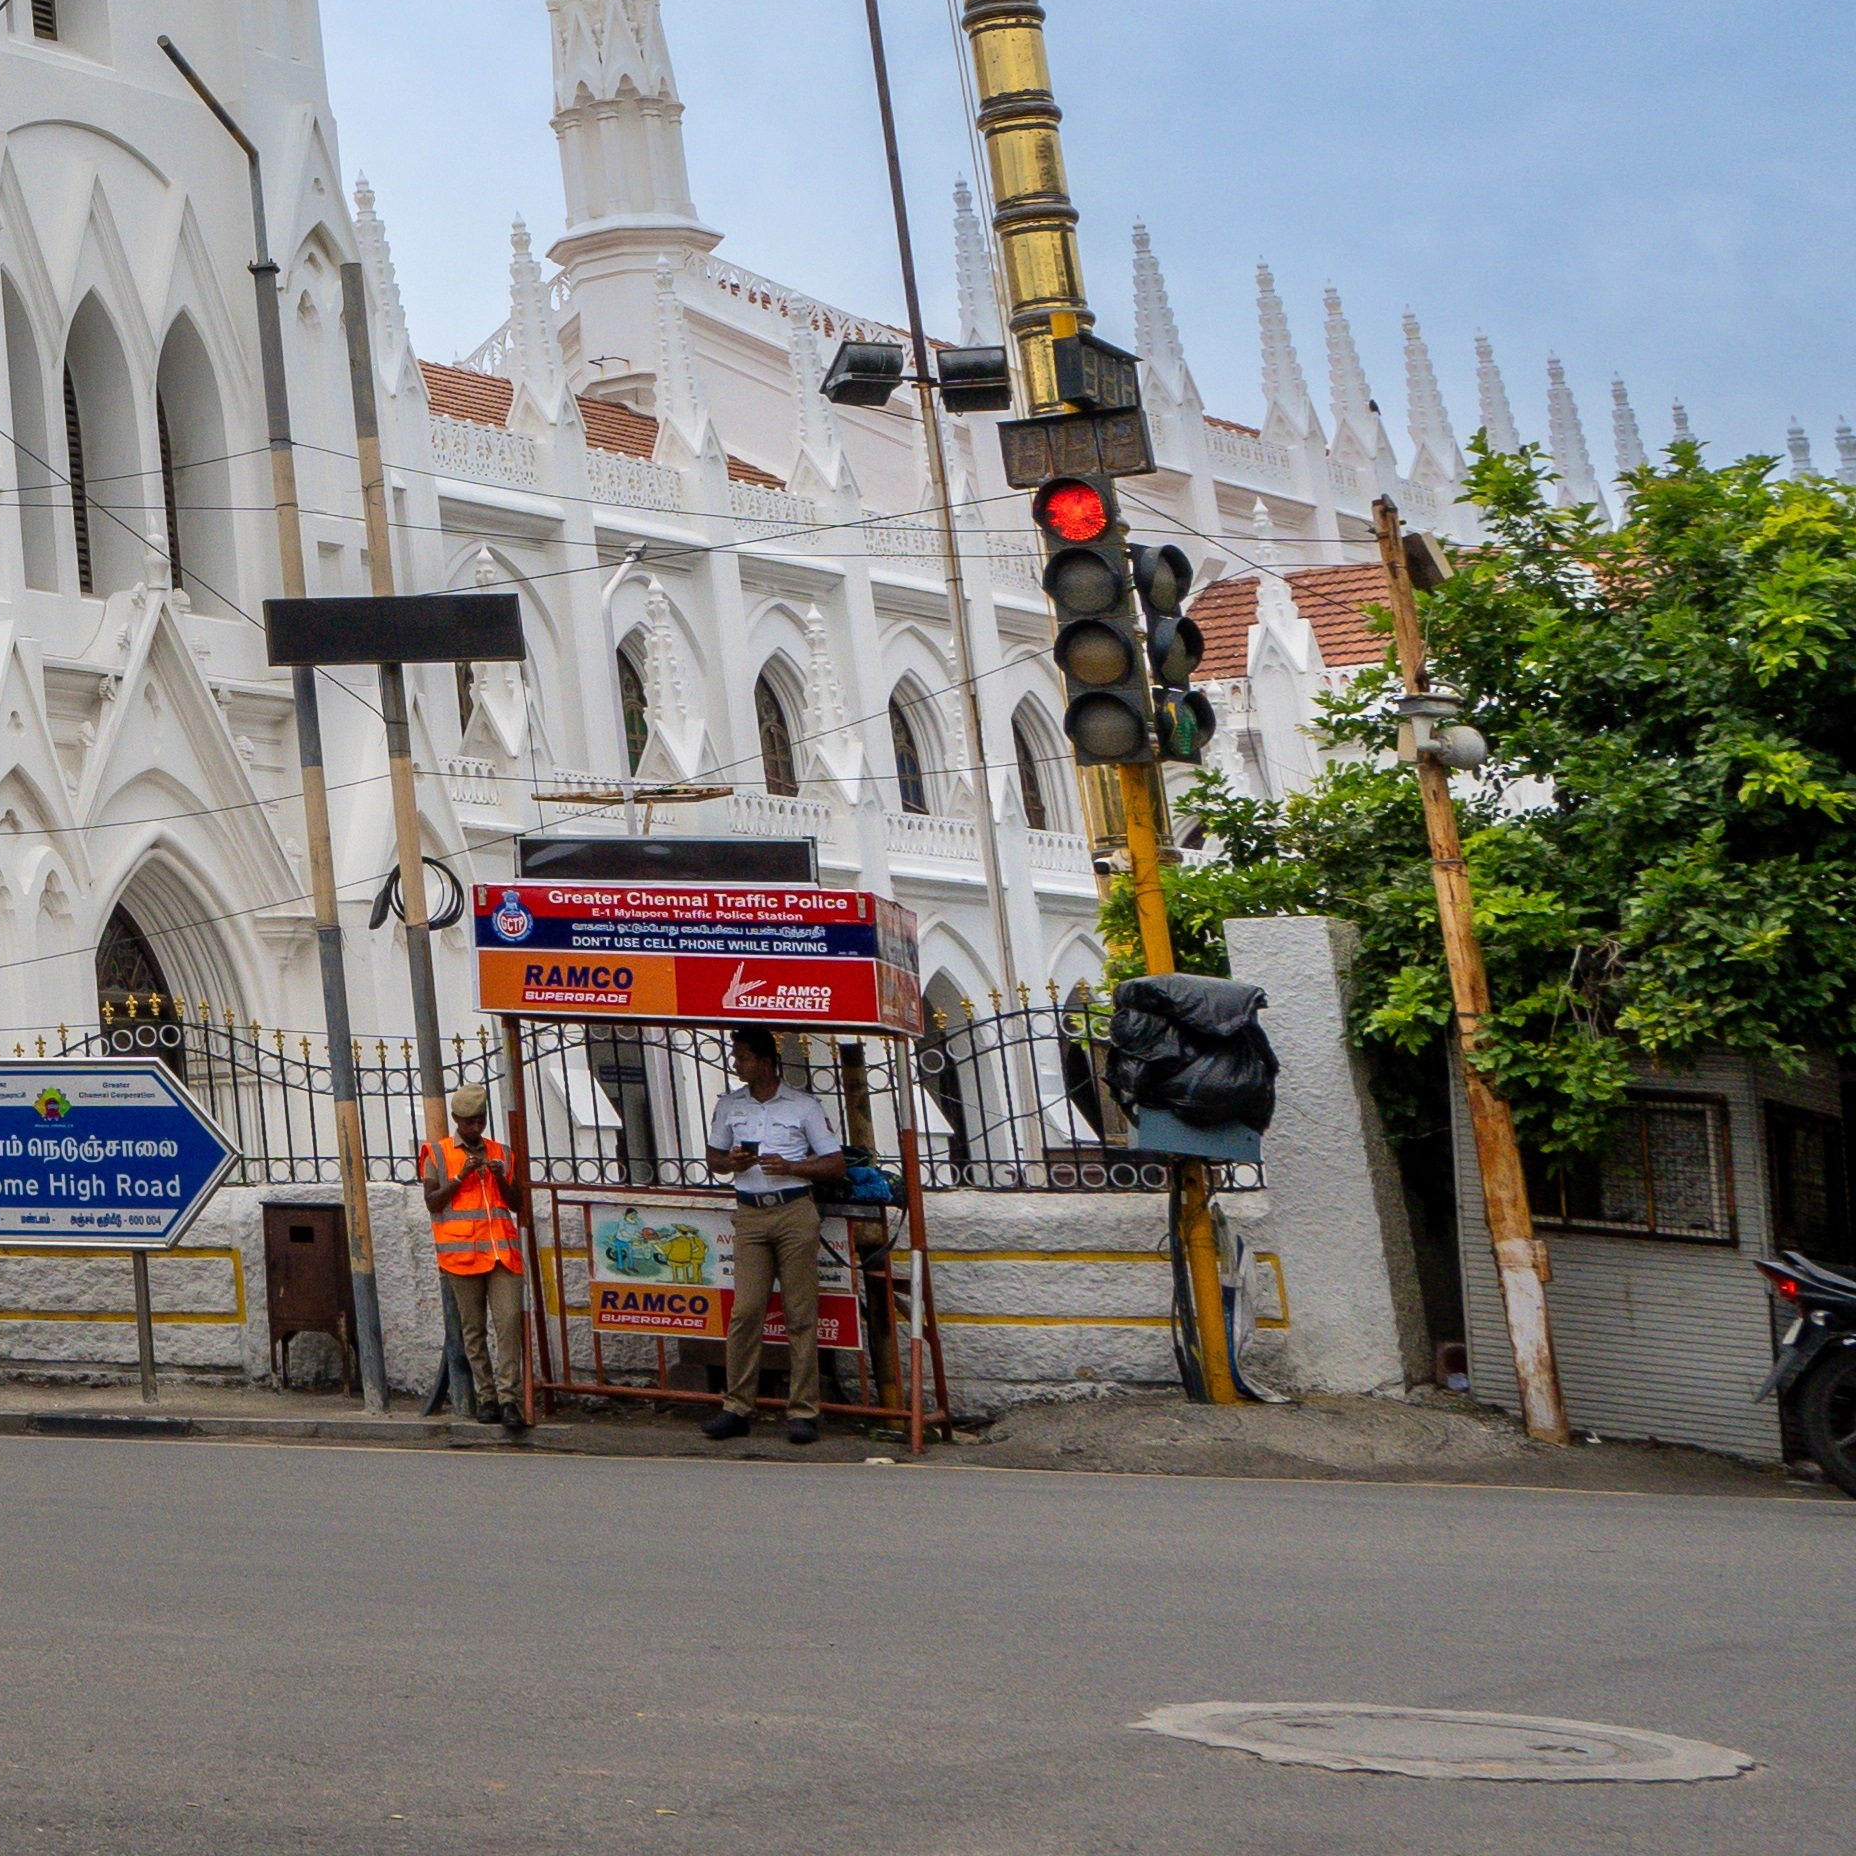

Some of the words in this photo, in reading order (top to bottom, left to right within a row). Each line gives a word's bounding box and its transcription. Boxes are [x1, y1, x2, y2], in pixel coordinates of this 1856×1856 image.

[548, 889, 621, 905] Greater
[626, 891, 708, 908] Chennai
[714, 893, 779, 909] Traffic
[784, 894, 848, 910] Police
[591, 907, 611, 918] E-1
[614, 908, 669, 919] Mylapore
[672, 910, 713, 920] Traffic
[715, 910, 755, 921] Police
[757, 911, 804, 922] Station
[501, 916, 525, 933] GCTP
[572, 936, 611, 948] DON'T
[614, 937, 640, 948] USE
[643, 938, 677, 950] CELL
[679, 940, 725, 951] PHONE
[728, 941, 770, 952] WHILE
[773, 942, 828, 954] DRIVING
[524, 964, 634, 990] RAMCO
[524, 991, 628, 1004] SUPERGRADE
[777, 985, 832, 998] RAMCO
[738, 995, 831, 1010] SUPERCRETE
[27, 1133, 179, 1163] நெடுஞ்சாலை
[49, 1173, 106, 1202] High
[116, 1174, 181, 1197] Road
[600, 1290, 710, 1315] RAMCO
[601, 1314, 704, 1328] SUPERGRADE
